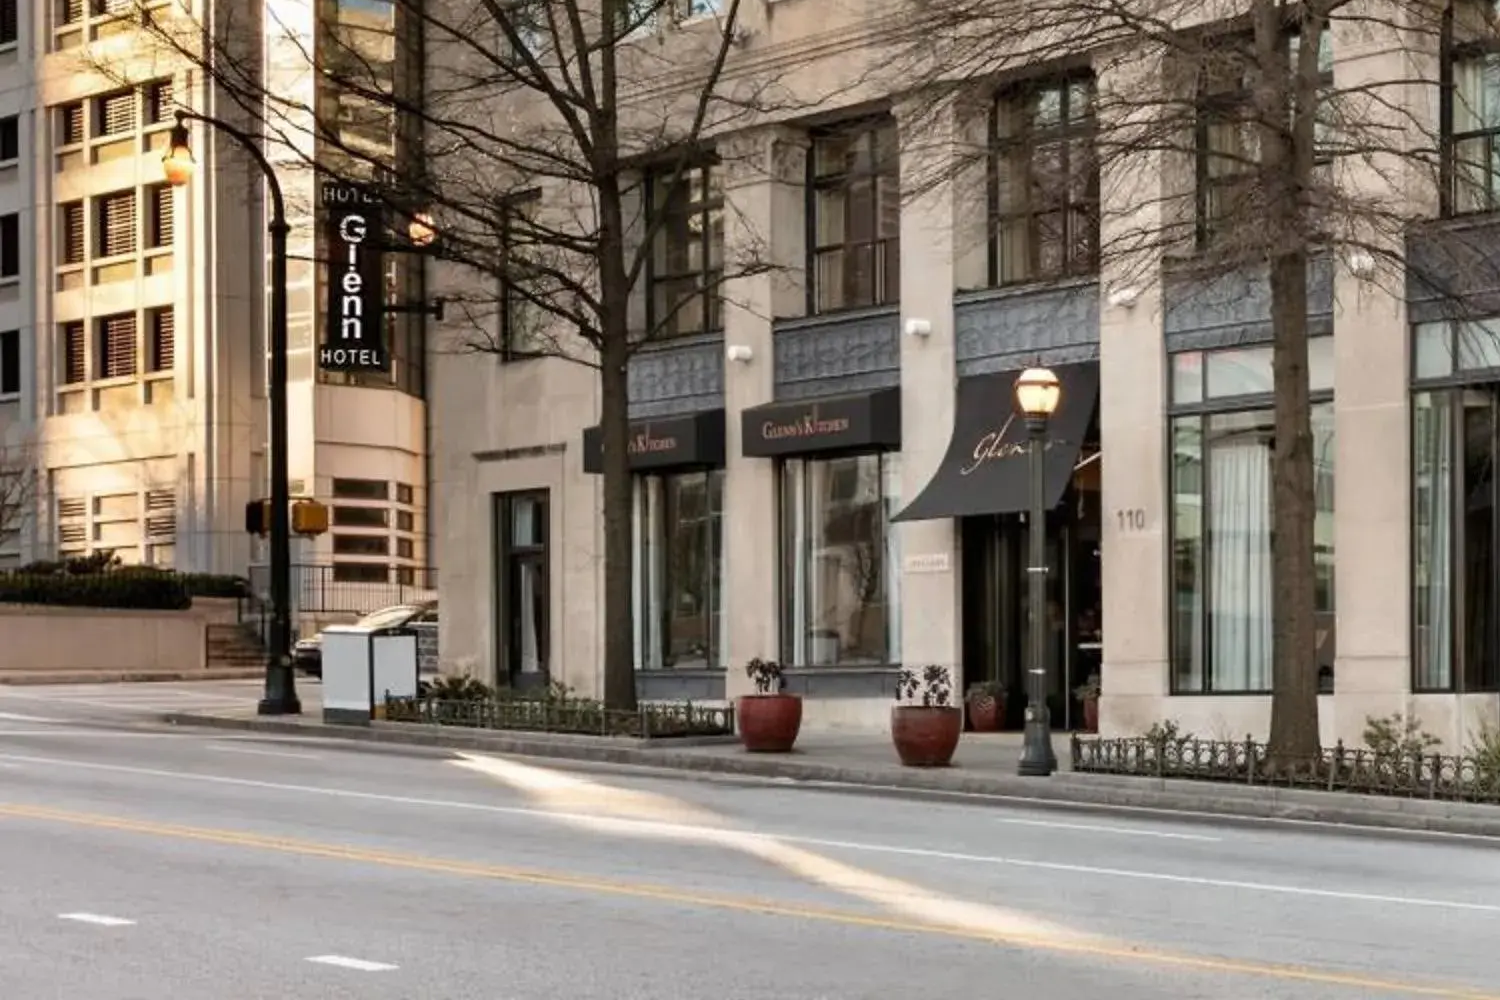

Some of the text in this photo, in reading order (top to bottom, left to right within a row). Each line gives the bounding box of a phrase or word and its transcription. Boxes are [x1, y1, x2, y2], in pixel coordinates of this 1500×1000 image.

[320, 349, 381, 365] HOTEL
[959, 411, 1066, 475] Glen
[1116, 508, 1145, 532] 110
